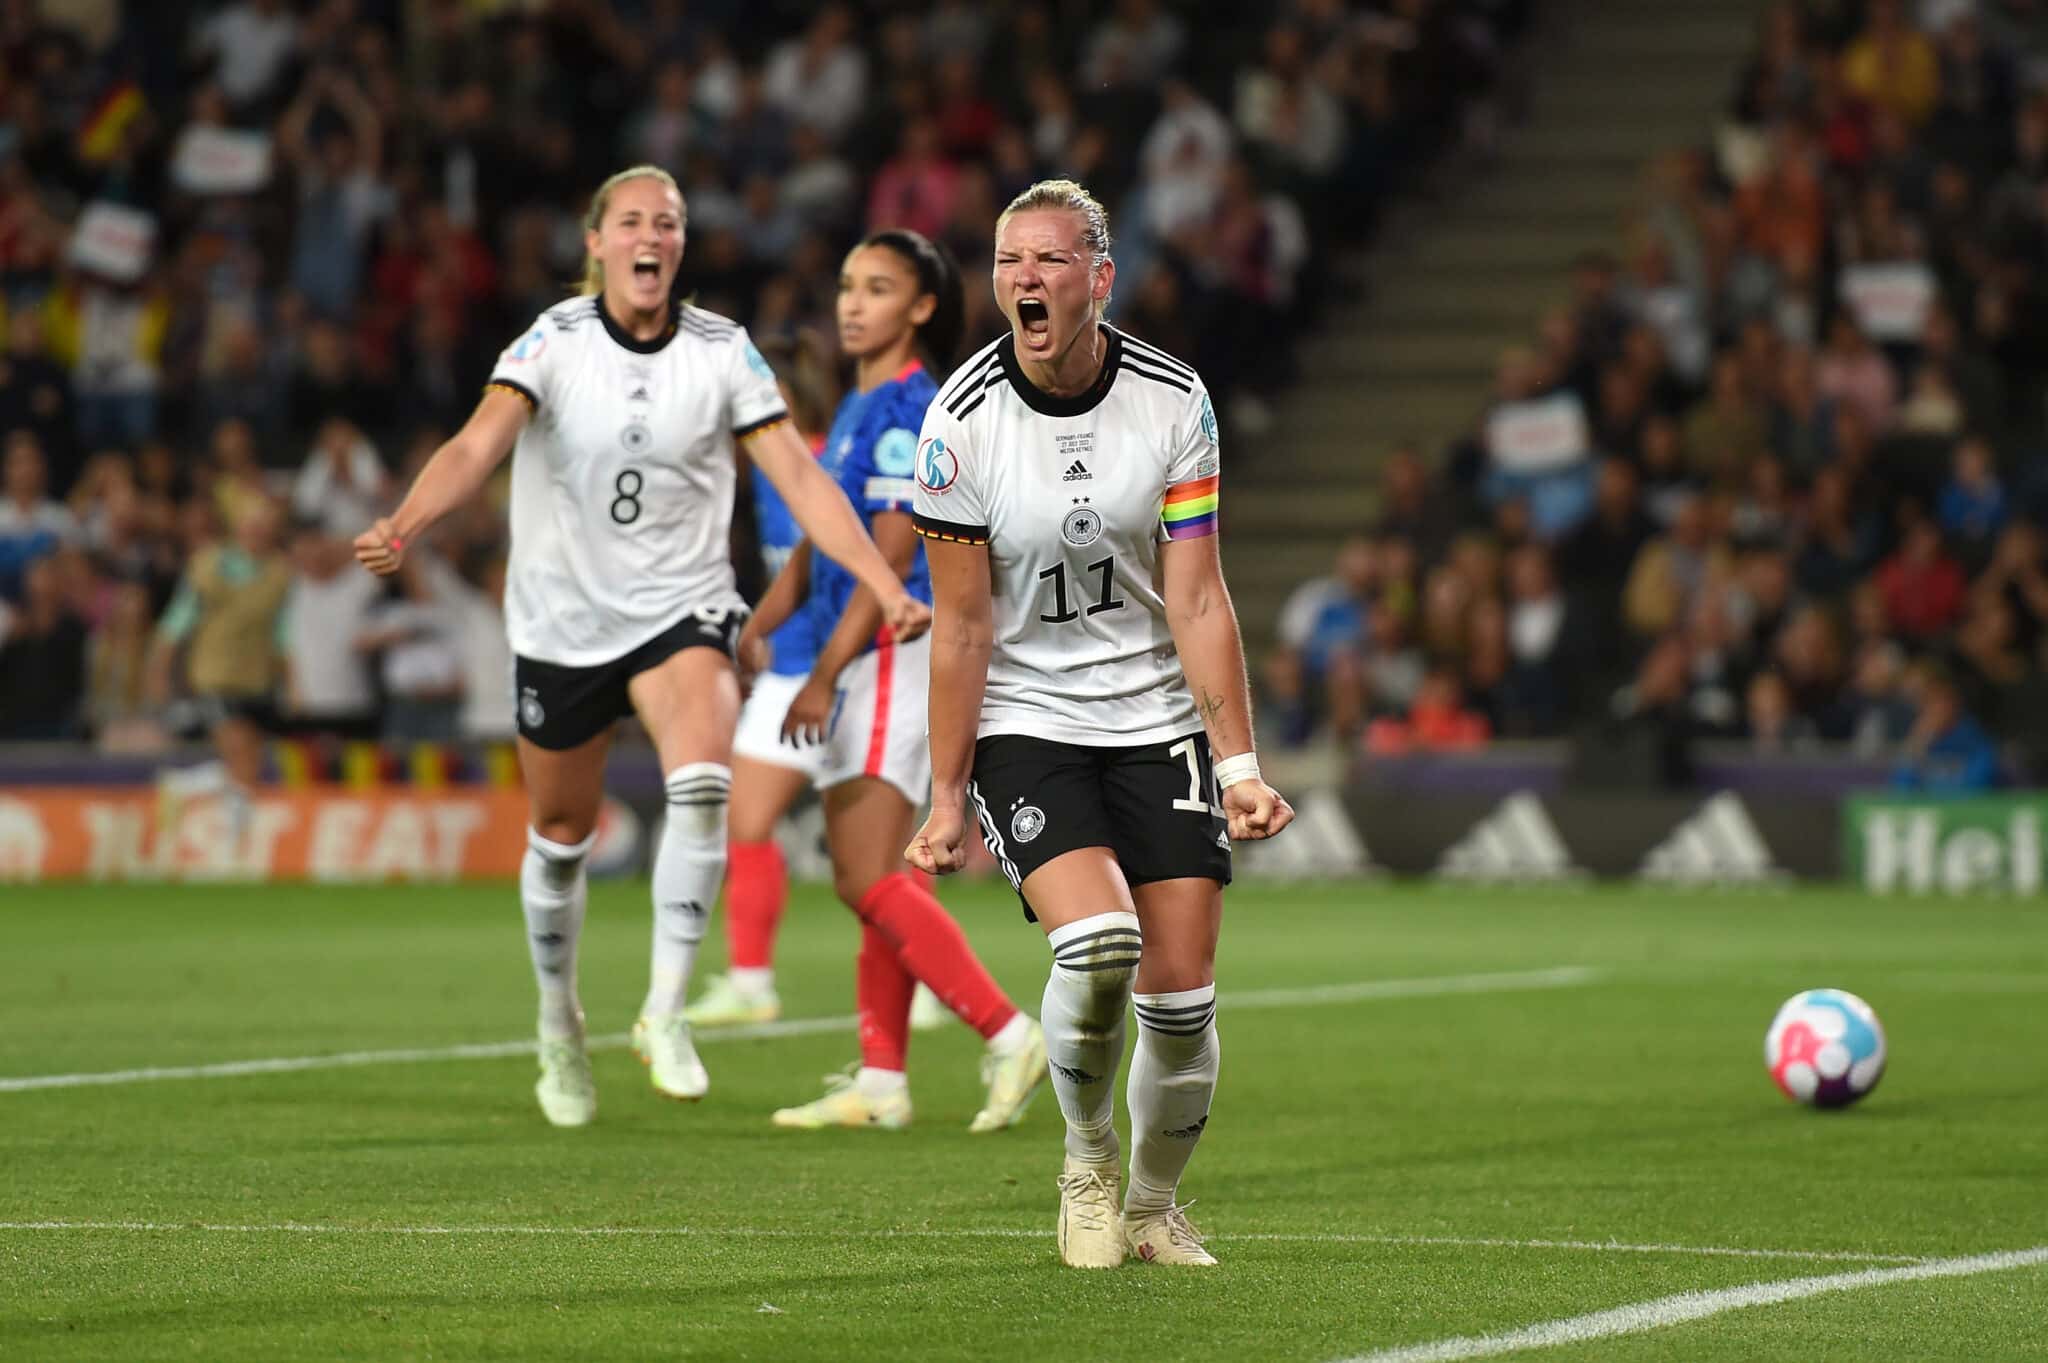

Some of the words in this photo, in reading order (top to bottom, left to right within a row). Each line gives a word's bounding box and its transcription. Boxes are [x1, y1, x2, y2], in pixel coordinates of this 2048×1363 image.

[610, 469, 643, 525] 8
[1062, 473, 1092, 481] adidas
[1038, 554, 1125, 624] 11
[310, 803, 484, 881] EAT
